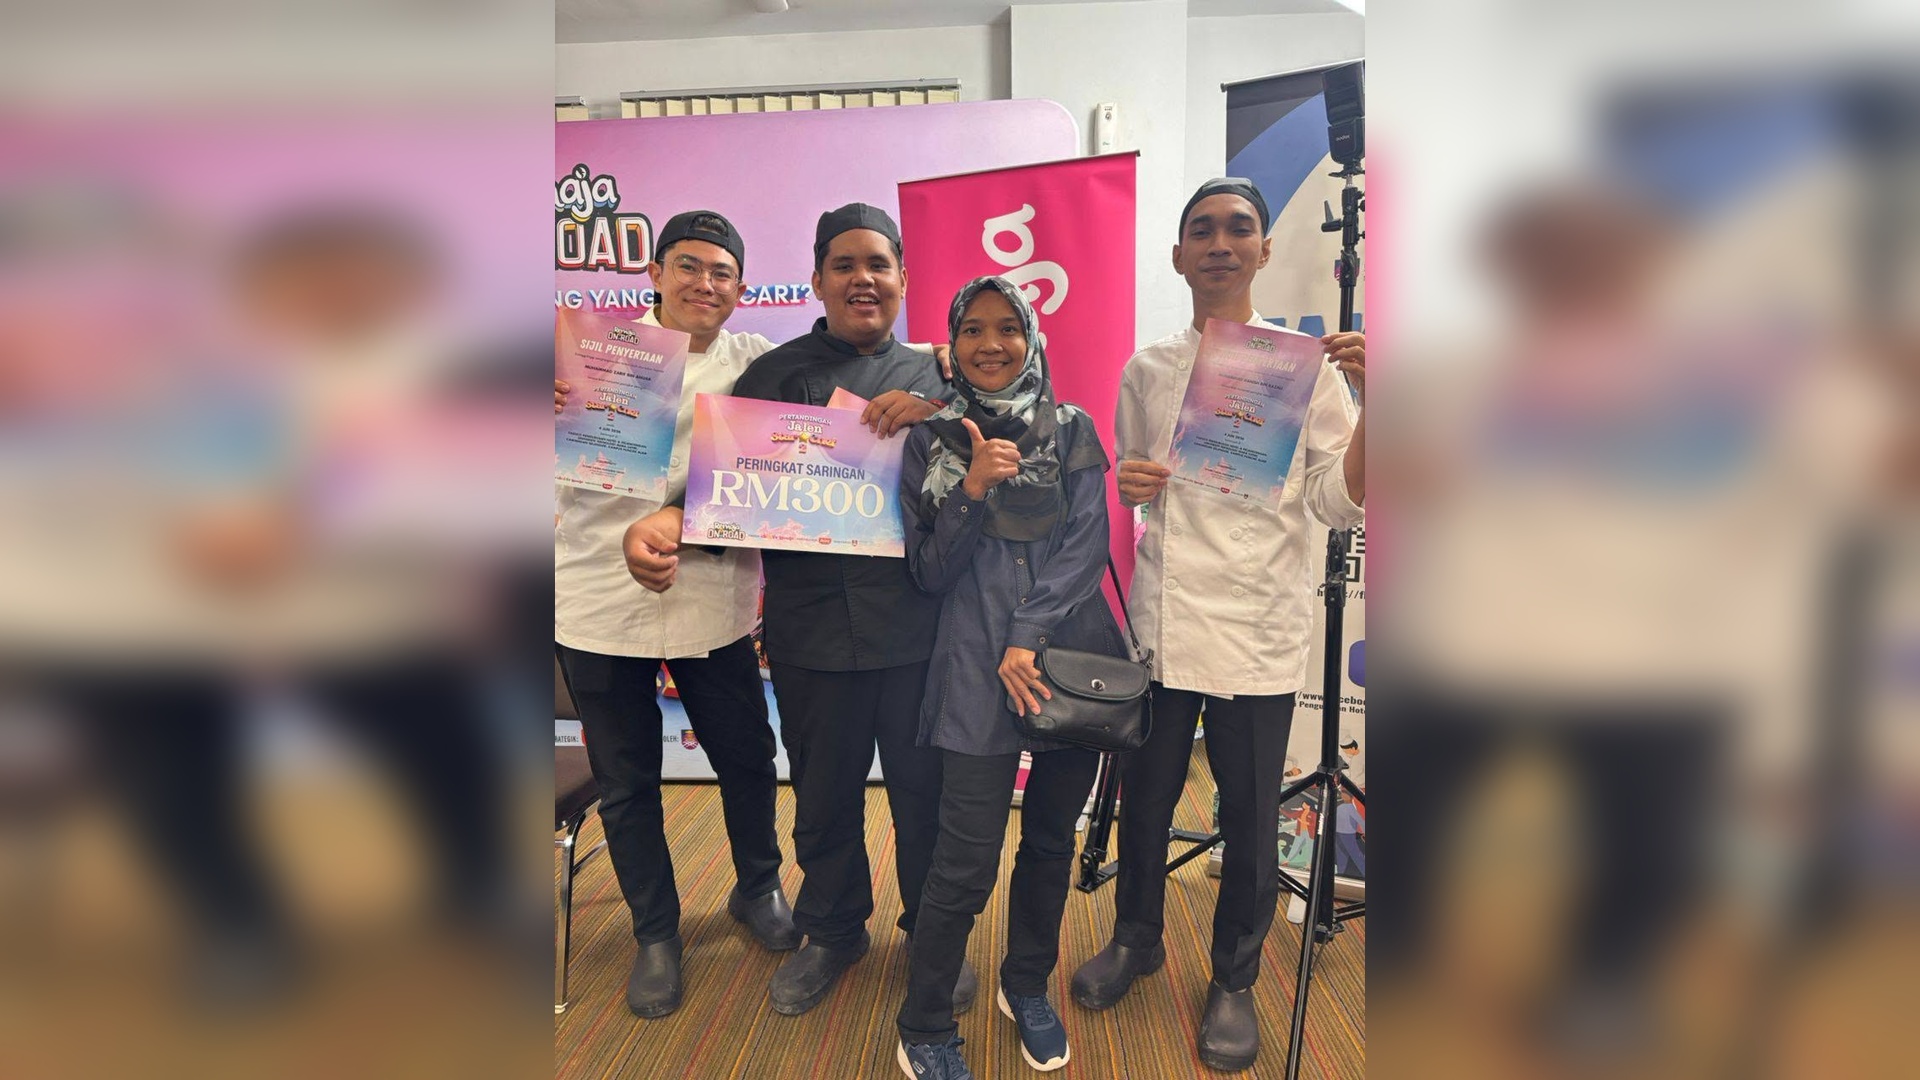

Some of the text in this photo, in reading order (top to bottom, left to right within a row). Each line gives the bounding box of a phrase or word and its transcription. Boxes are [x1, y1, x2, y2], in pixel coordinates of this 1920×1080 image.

[556, 216, 651, 271] OAD
[588, 288, 655, 310] YANG
[740, 284, 813, 305] CARI?
[580, 338, 603, 353] SIJIL
[605, 344, 664, 365] PENYERTAAN
[599, 392, 630, 406] Jalen
[778, 413, 833, 426] PERTANDINGAN
[786, 419, 823, 434] Jalen
[736, 457, 865, 480] PERINGKAT SARINGAN
[709, 470, 885, 518] RM300
